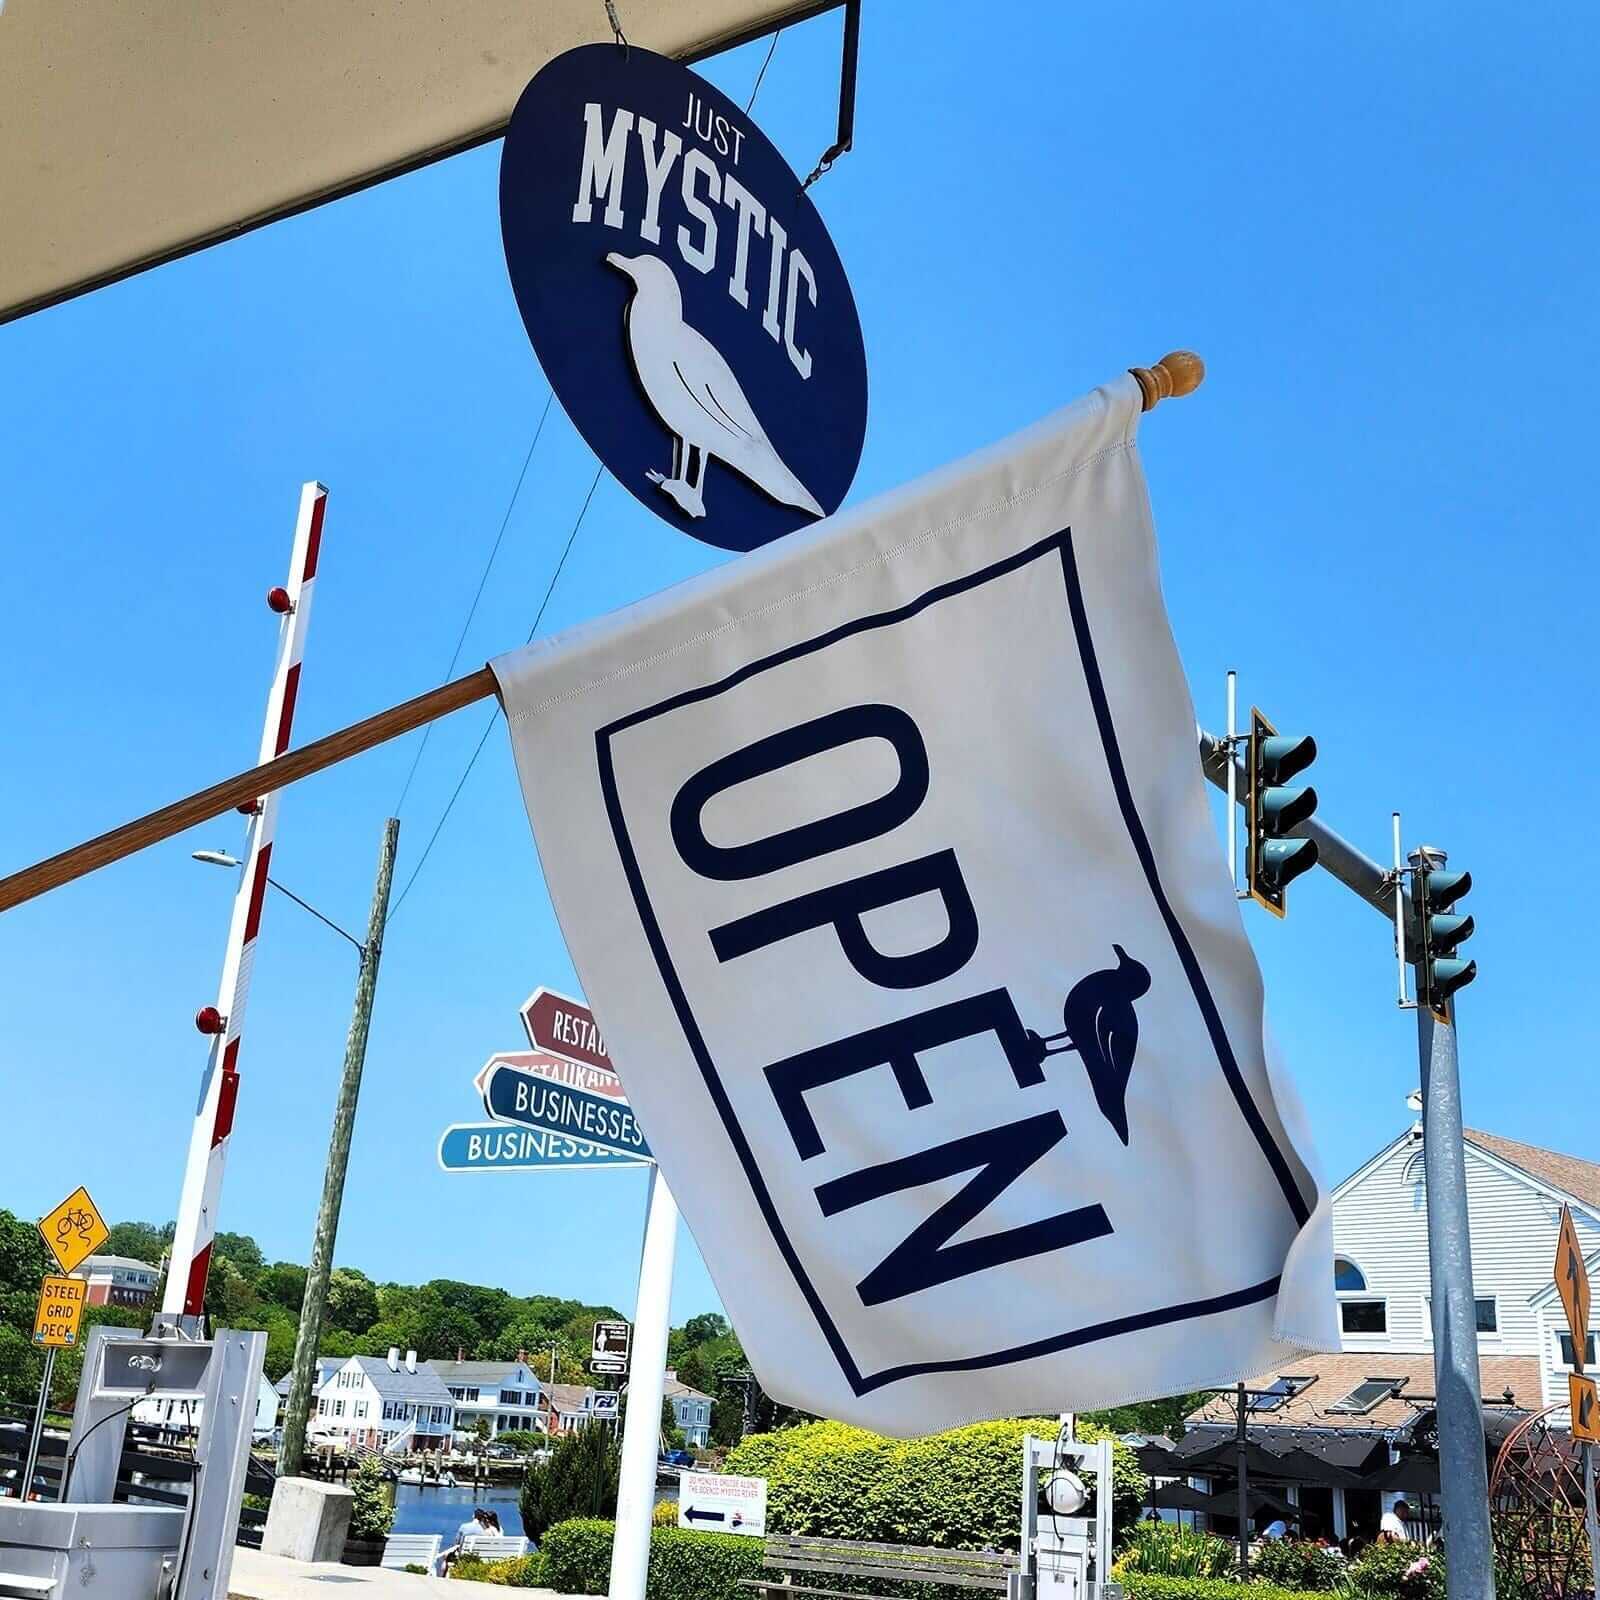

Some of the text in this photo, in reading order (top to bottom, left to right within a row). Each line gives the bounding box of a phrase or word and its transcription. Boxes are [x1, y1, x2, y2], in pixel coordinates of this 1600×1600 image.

[682, 92, 746, 166] JUST
[571, 102, 818, 380] MYSTIC
[669, 703, 1115, 1307] OPEN
[515, 1081, 643, 1146] BUSINESSES
[467, 1131, 622, 1161] BUSINESS
[45, 1284, 81, 1300] STEEL
[47, 1304, 74, 1318] GRID
[41, 1323, 72, 1338] DECK
